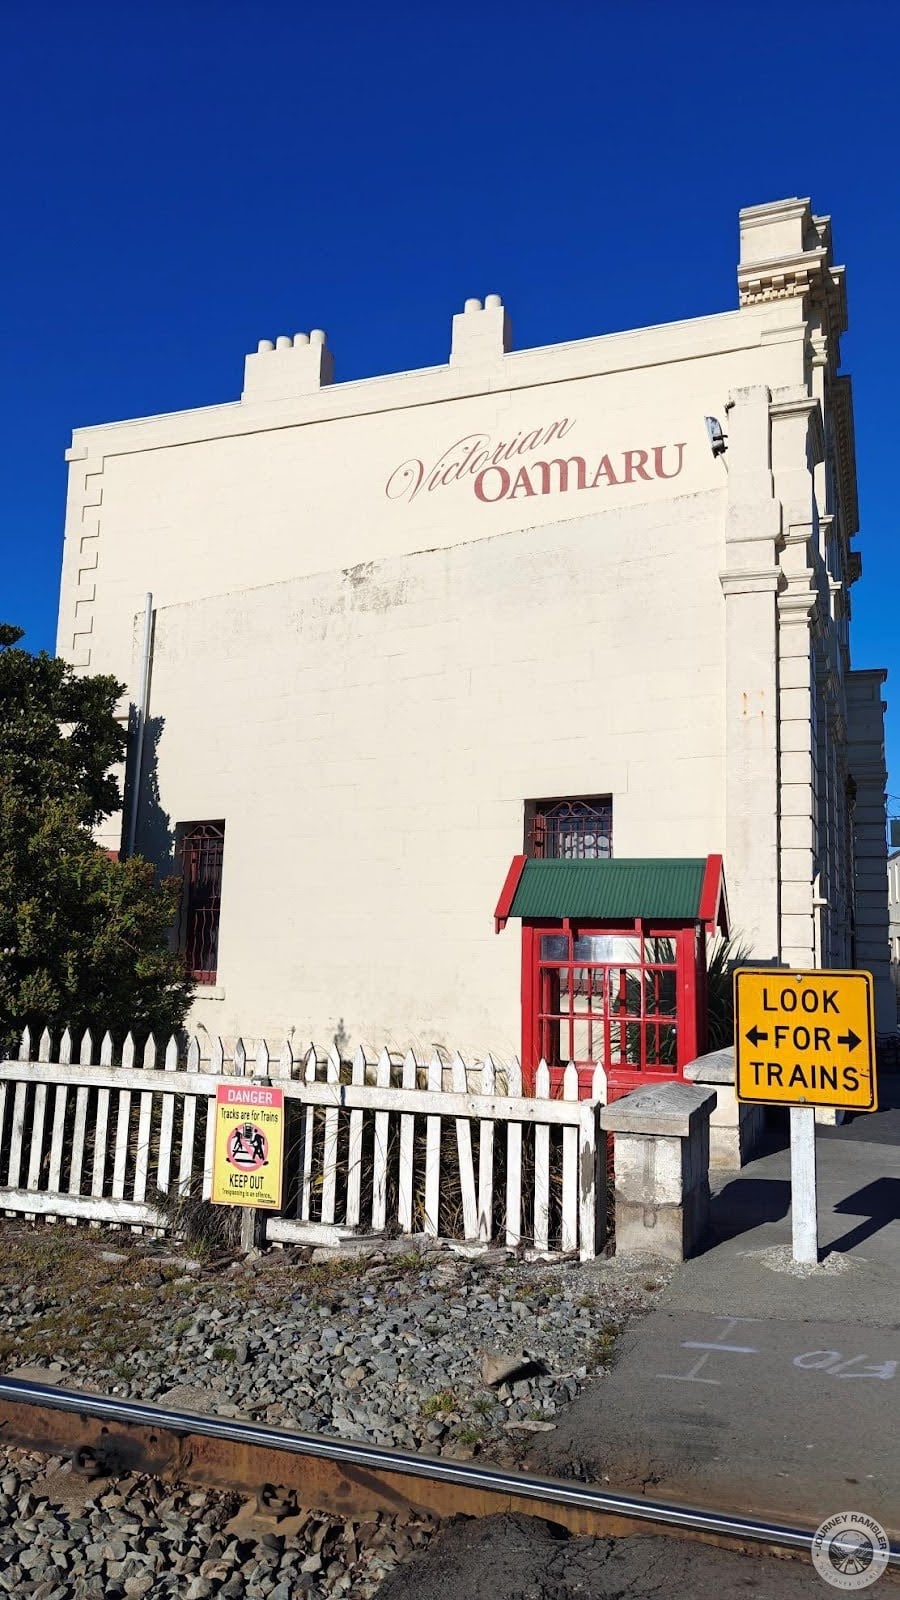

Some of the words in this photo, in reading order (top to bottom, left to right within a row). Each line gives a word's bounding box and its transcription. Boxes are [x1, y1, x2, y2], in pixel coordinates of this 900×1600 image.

[385, 417, 577, 503] Victorian
[474, 442, 688, 503] OAMARU
[763, 988, 840, 1014] LOOK
[775, 1025, 831, 1052] FOR
[749, 1062, 859, 1092] TRAINS
[227, 1089, 273, 1105] DANGER
[221, 1107, 239, 1120] Tracks
[240, 1111, 250, 1120] are
[251, 1109, 260, 1121] for
[261, 1110, 278, 1123] Trains
[229, 1173, 248, 1189] KEEP
[249, 1176, 264, 1190] OUT
